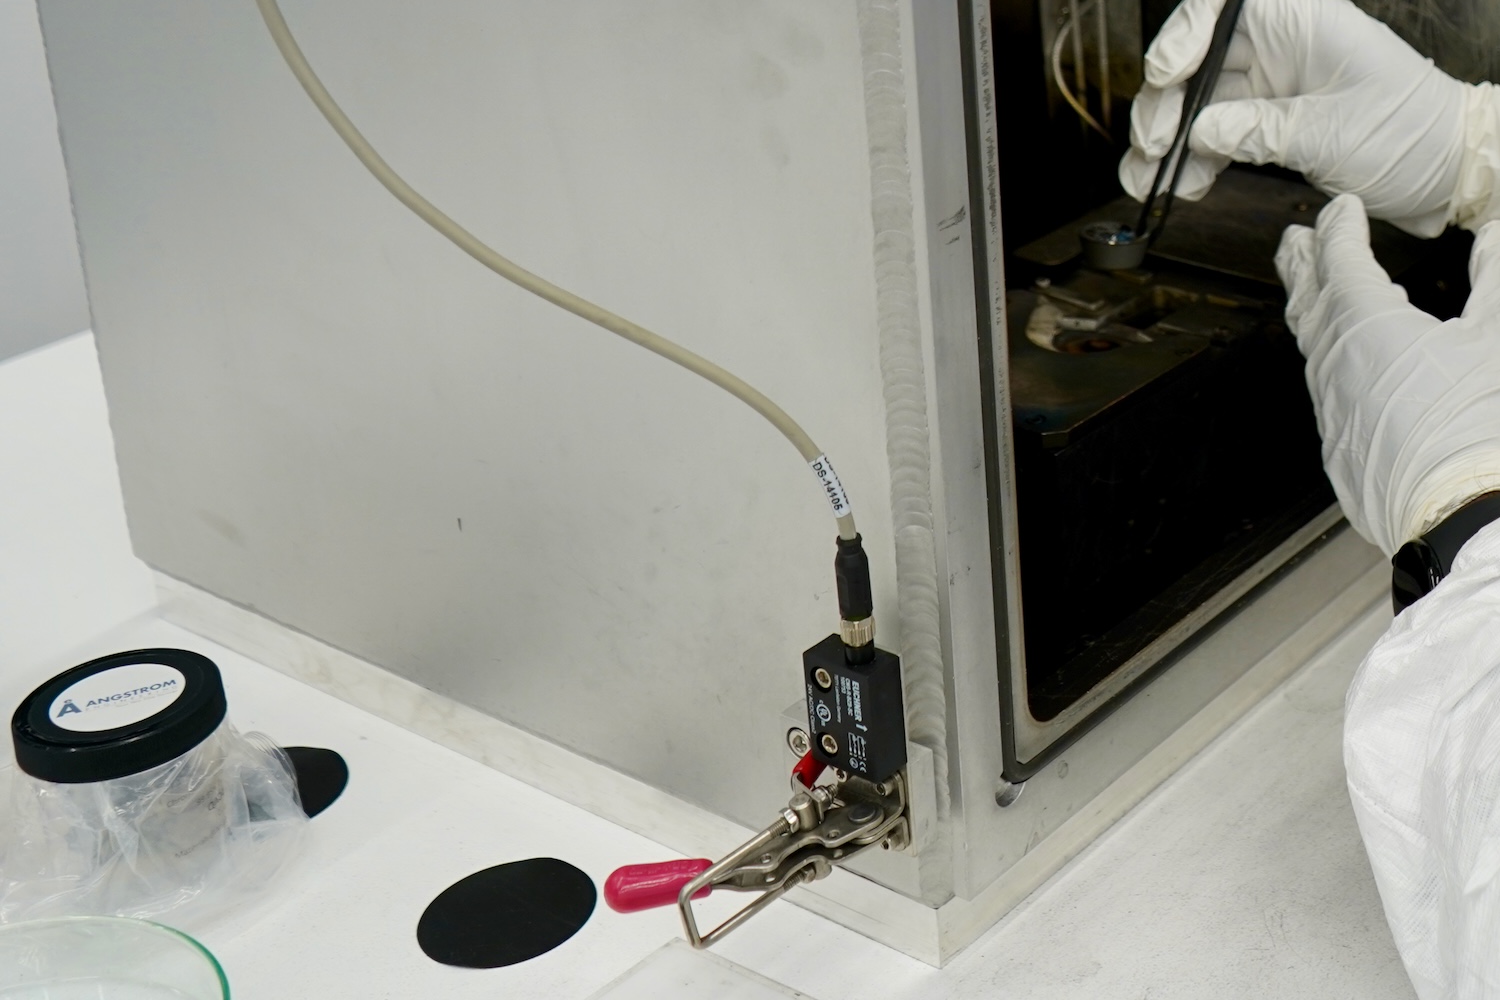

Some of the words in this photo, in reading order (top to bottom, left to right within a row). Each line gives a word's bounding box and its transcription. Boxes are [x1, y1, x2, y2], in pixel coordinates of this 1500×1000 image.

[812, 461, 843, 512] DS-14105
[86, 680, 176, 707] ANGSTROM
[852, 680, 863, 722] EUCHNER
